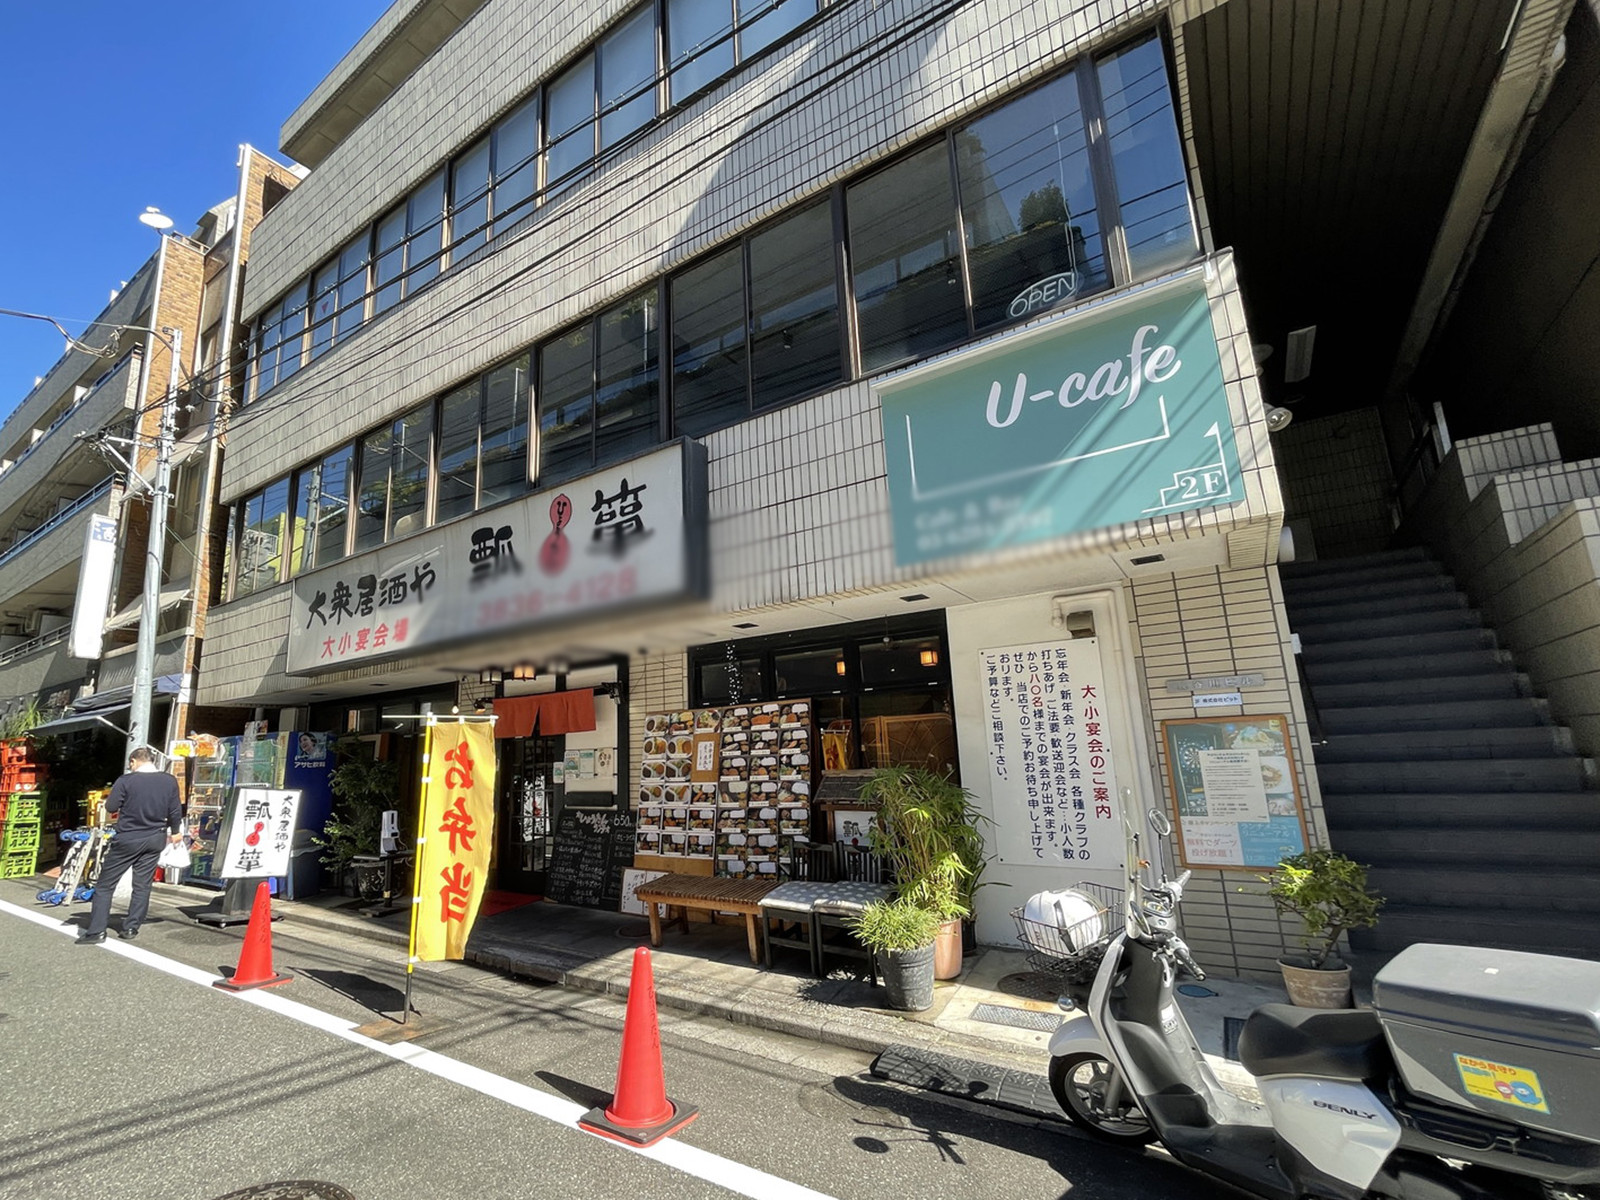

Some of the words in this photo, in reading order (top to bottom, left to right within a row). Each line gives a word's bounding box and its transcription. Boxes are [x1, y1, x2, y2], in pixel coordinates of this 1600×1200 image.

[1009, 275, 1077, 318] OPEN
[985, 324, 1183, 429] U-cafe
[1180, 470, 1223, 500] 2F
[321, 616, 410, 659] 大小宴会場
[294, 761, 326, 769] アサヒ飲料
[1313, 1099, 1378, 1120] BENLY
